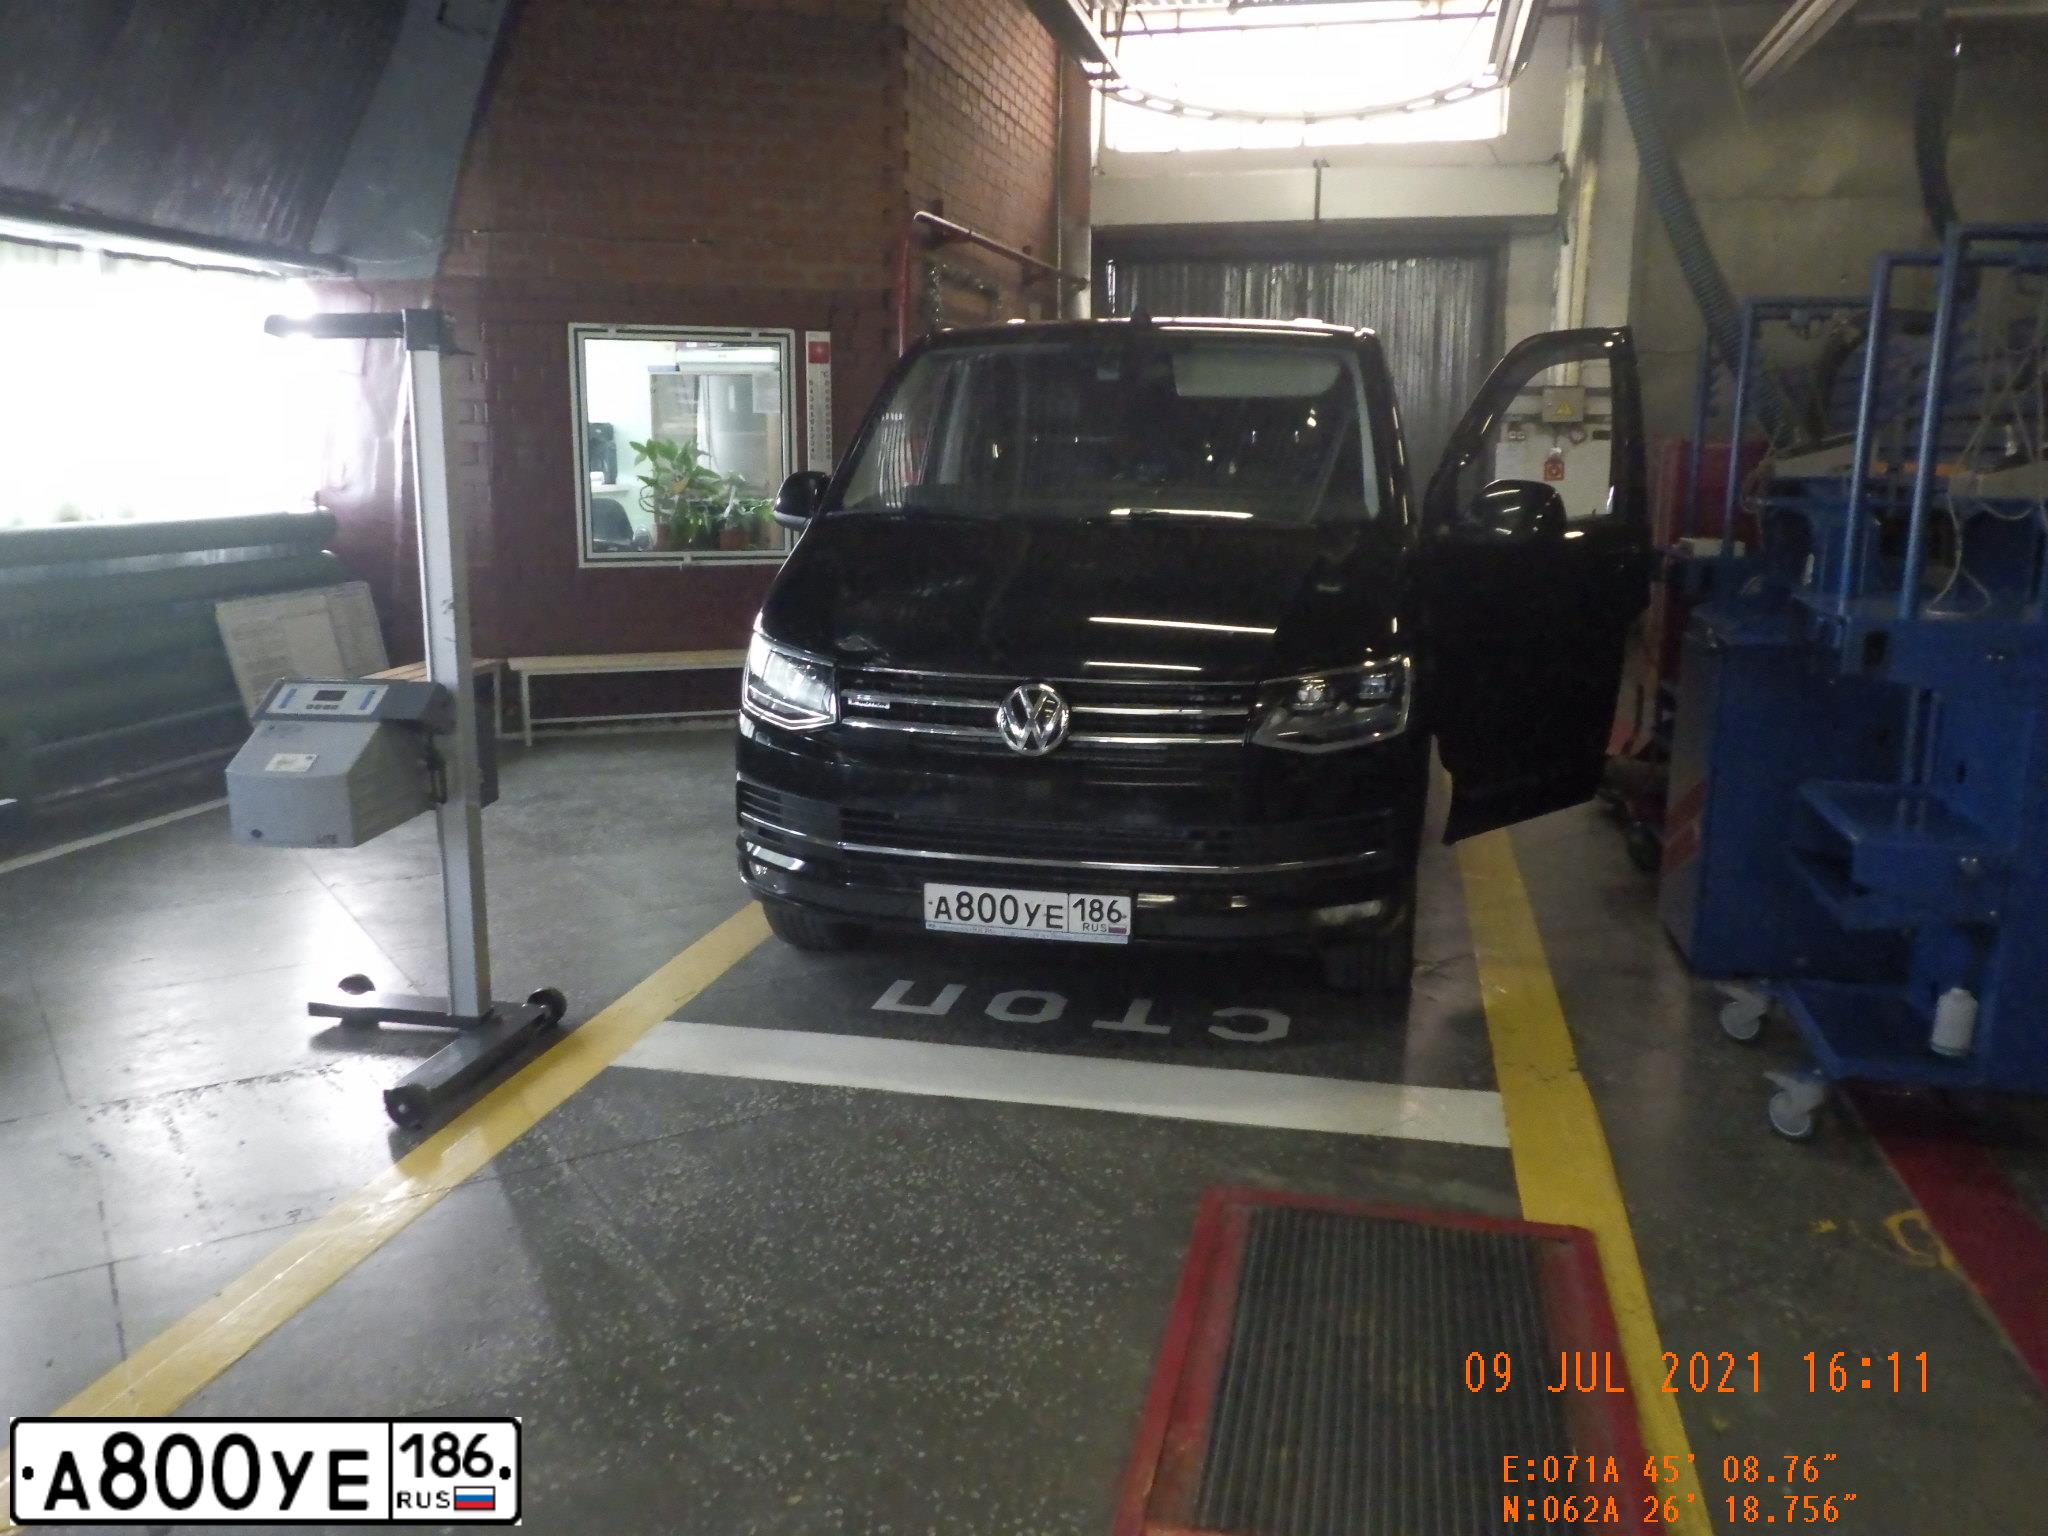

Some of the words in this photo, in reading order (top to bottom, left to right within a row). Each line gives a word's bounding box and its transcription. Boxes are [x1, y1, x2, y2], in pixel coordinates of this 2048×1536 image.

[1072, 897, 1123, 924] 186
[1082, 922, 1108, 934] RUS
[870, 978, 1291, 1043] СТОП
